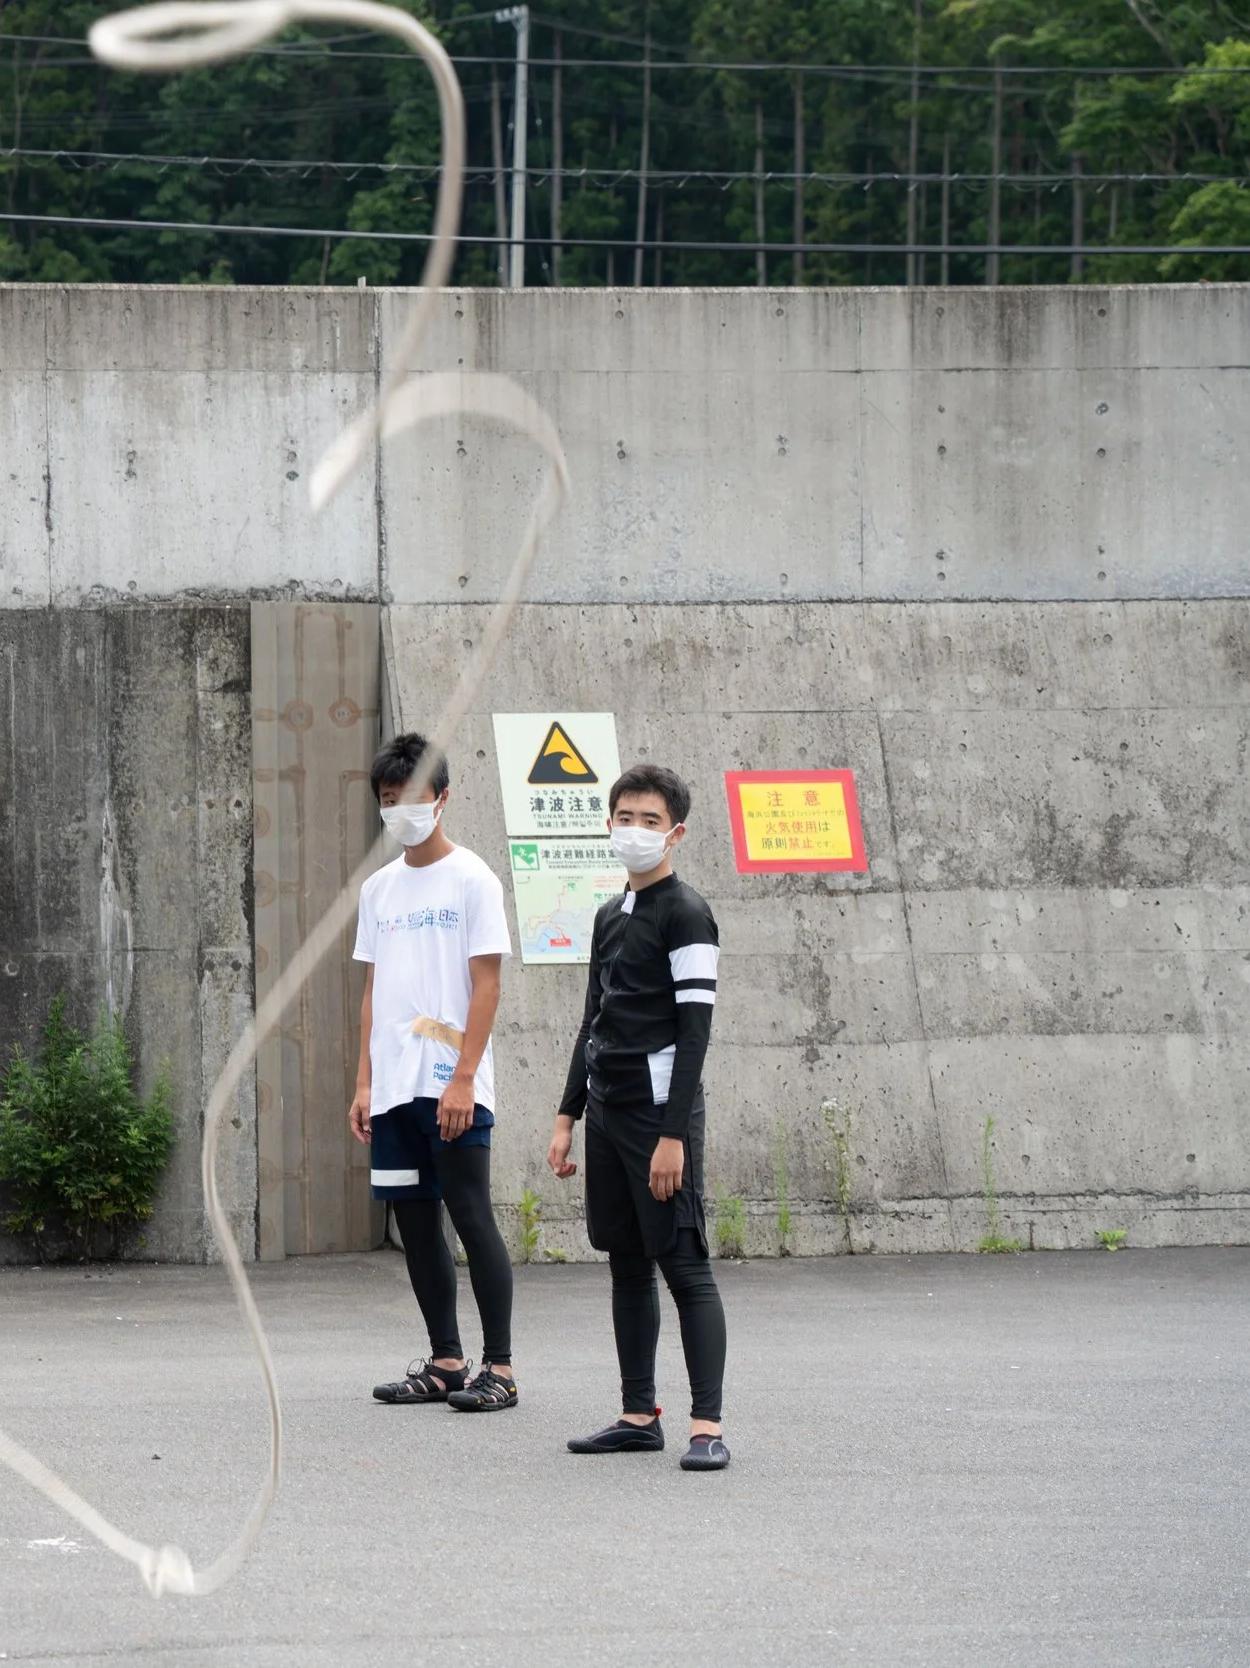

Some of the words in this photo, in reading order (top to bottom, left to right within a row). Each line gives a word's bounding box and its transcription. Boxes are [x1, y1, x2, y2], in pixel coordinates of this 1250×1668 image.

[529, 796, 603, 812] 津波注意
[767, 790, 821, 807] 注意
[765, 821, 831, 834] 火気使用は
